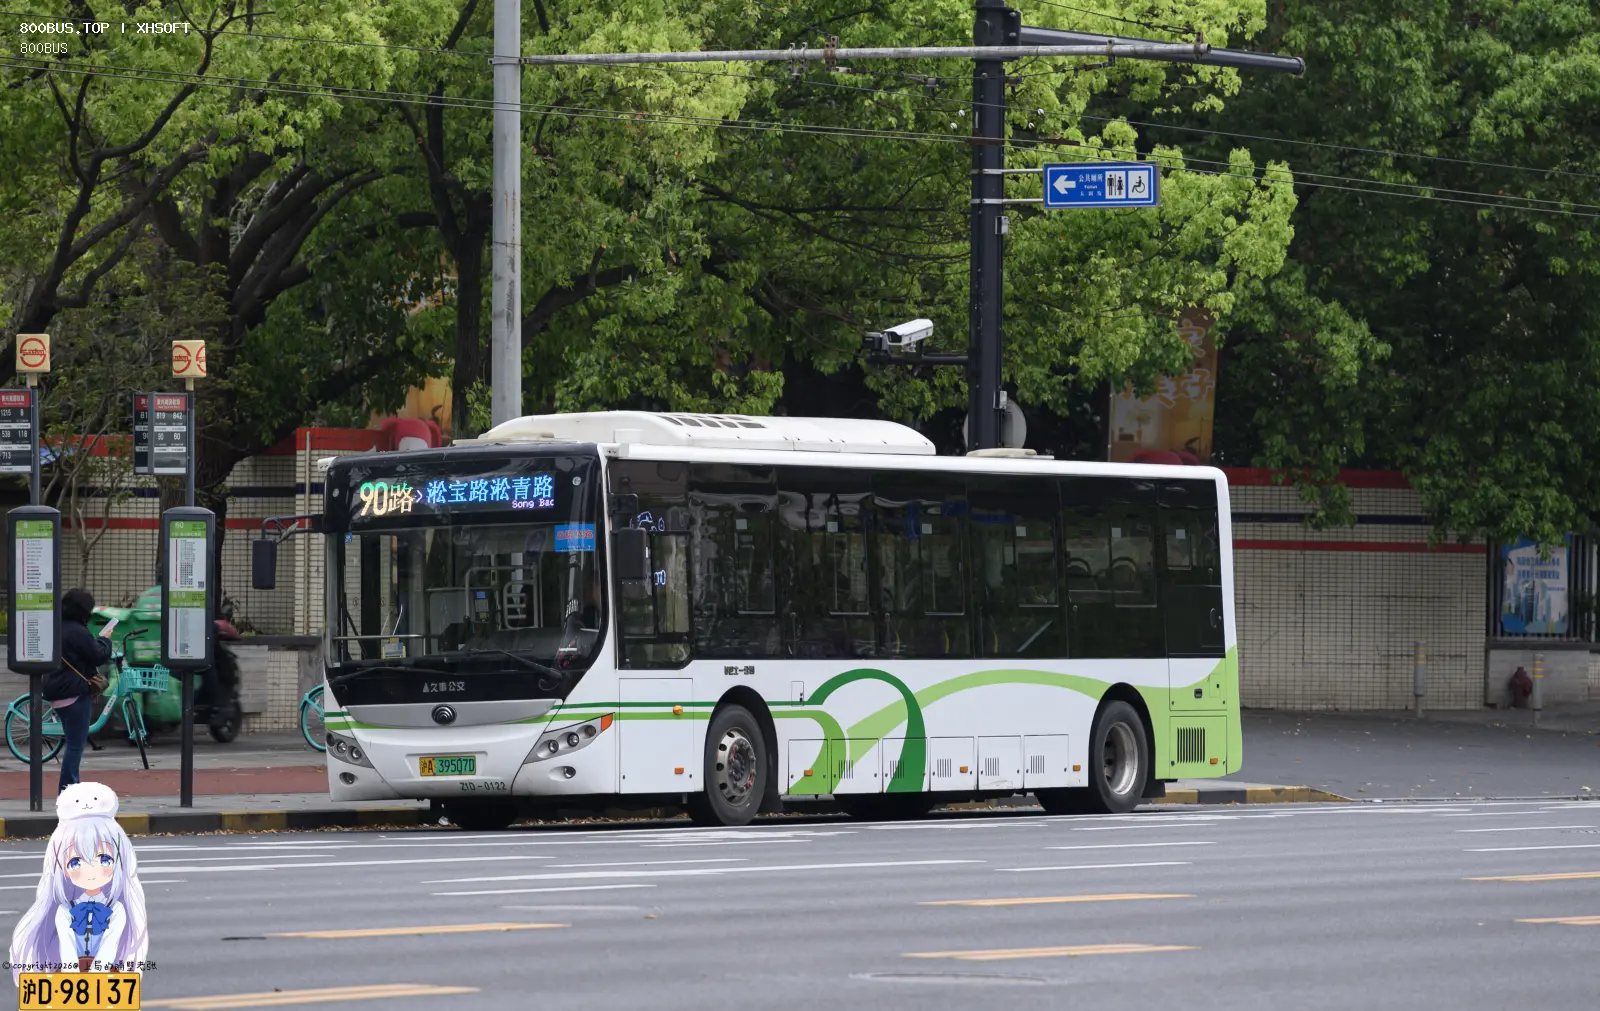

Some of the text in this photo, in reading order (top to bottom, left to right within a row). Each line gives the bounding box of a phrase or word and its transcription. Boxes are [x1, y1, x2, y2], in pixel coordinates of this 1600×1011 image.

[360, 482, 414, 516] 90路
[426, 475, 553, 504] 淞宝路淞青路
[512, 499, 534, 509] Song
